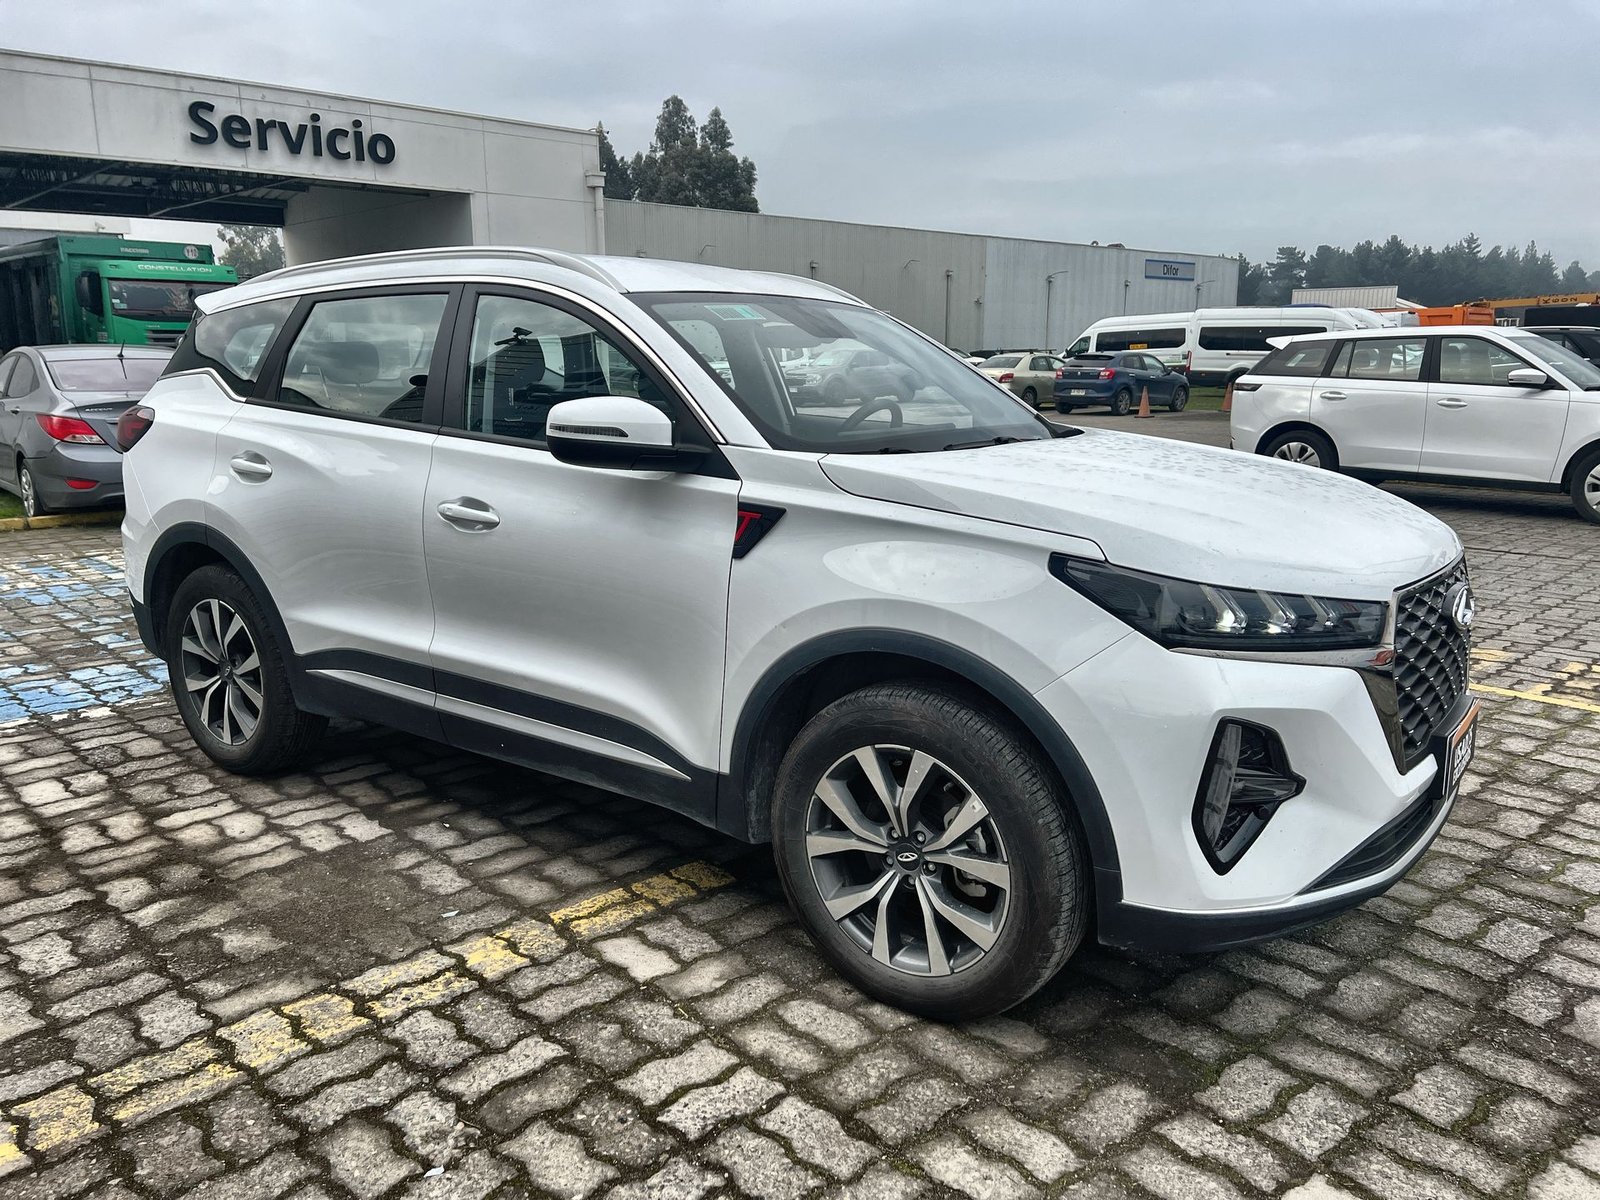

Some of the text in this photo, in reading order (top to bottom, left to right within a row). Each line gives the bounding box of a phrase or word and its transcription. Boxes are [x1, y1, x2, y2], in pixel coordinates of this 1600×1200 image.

[188, 100, 396, 165] Servicio
[137, 264, 213, 272] CONSTELLATION
[1162, 264, 1179, 276] Difor
